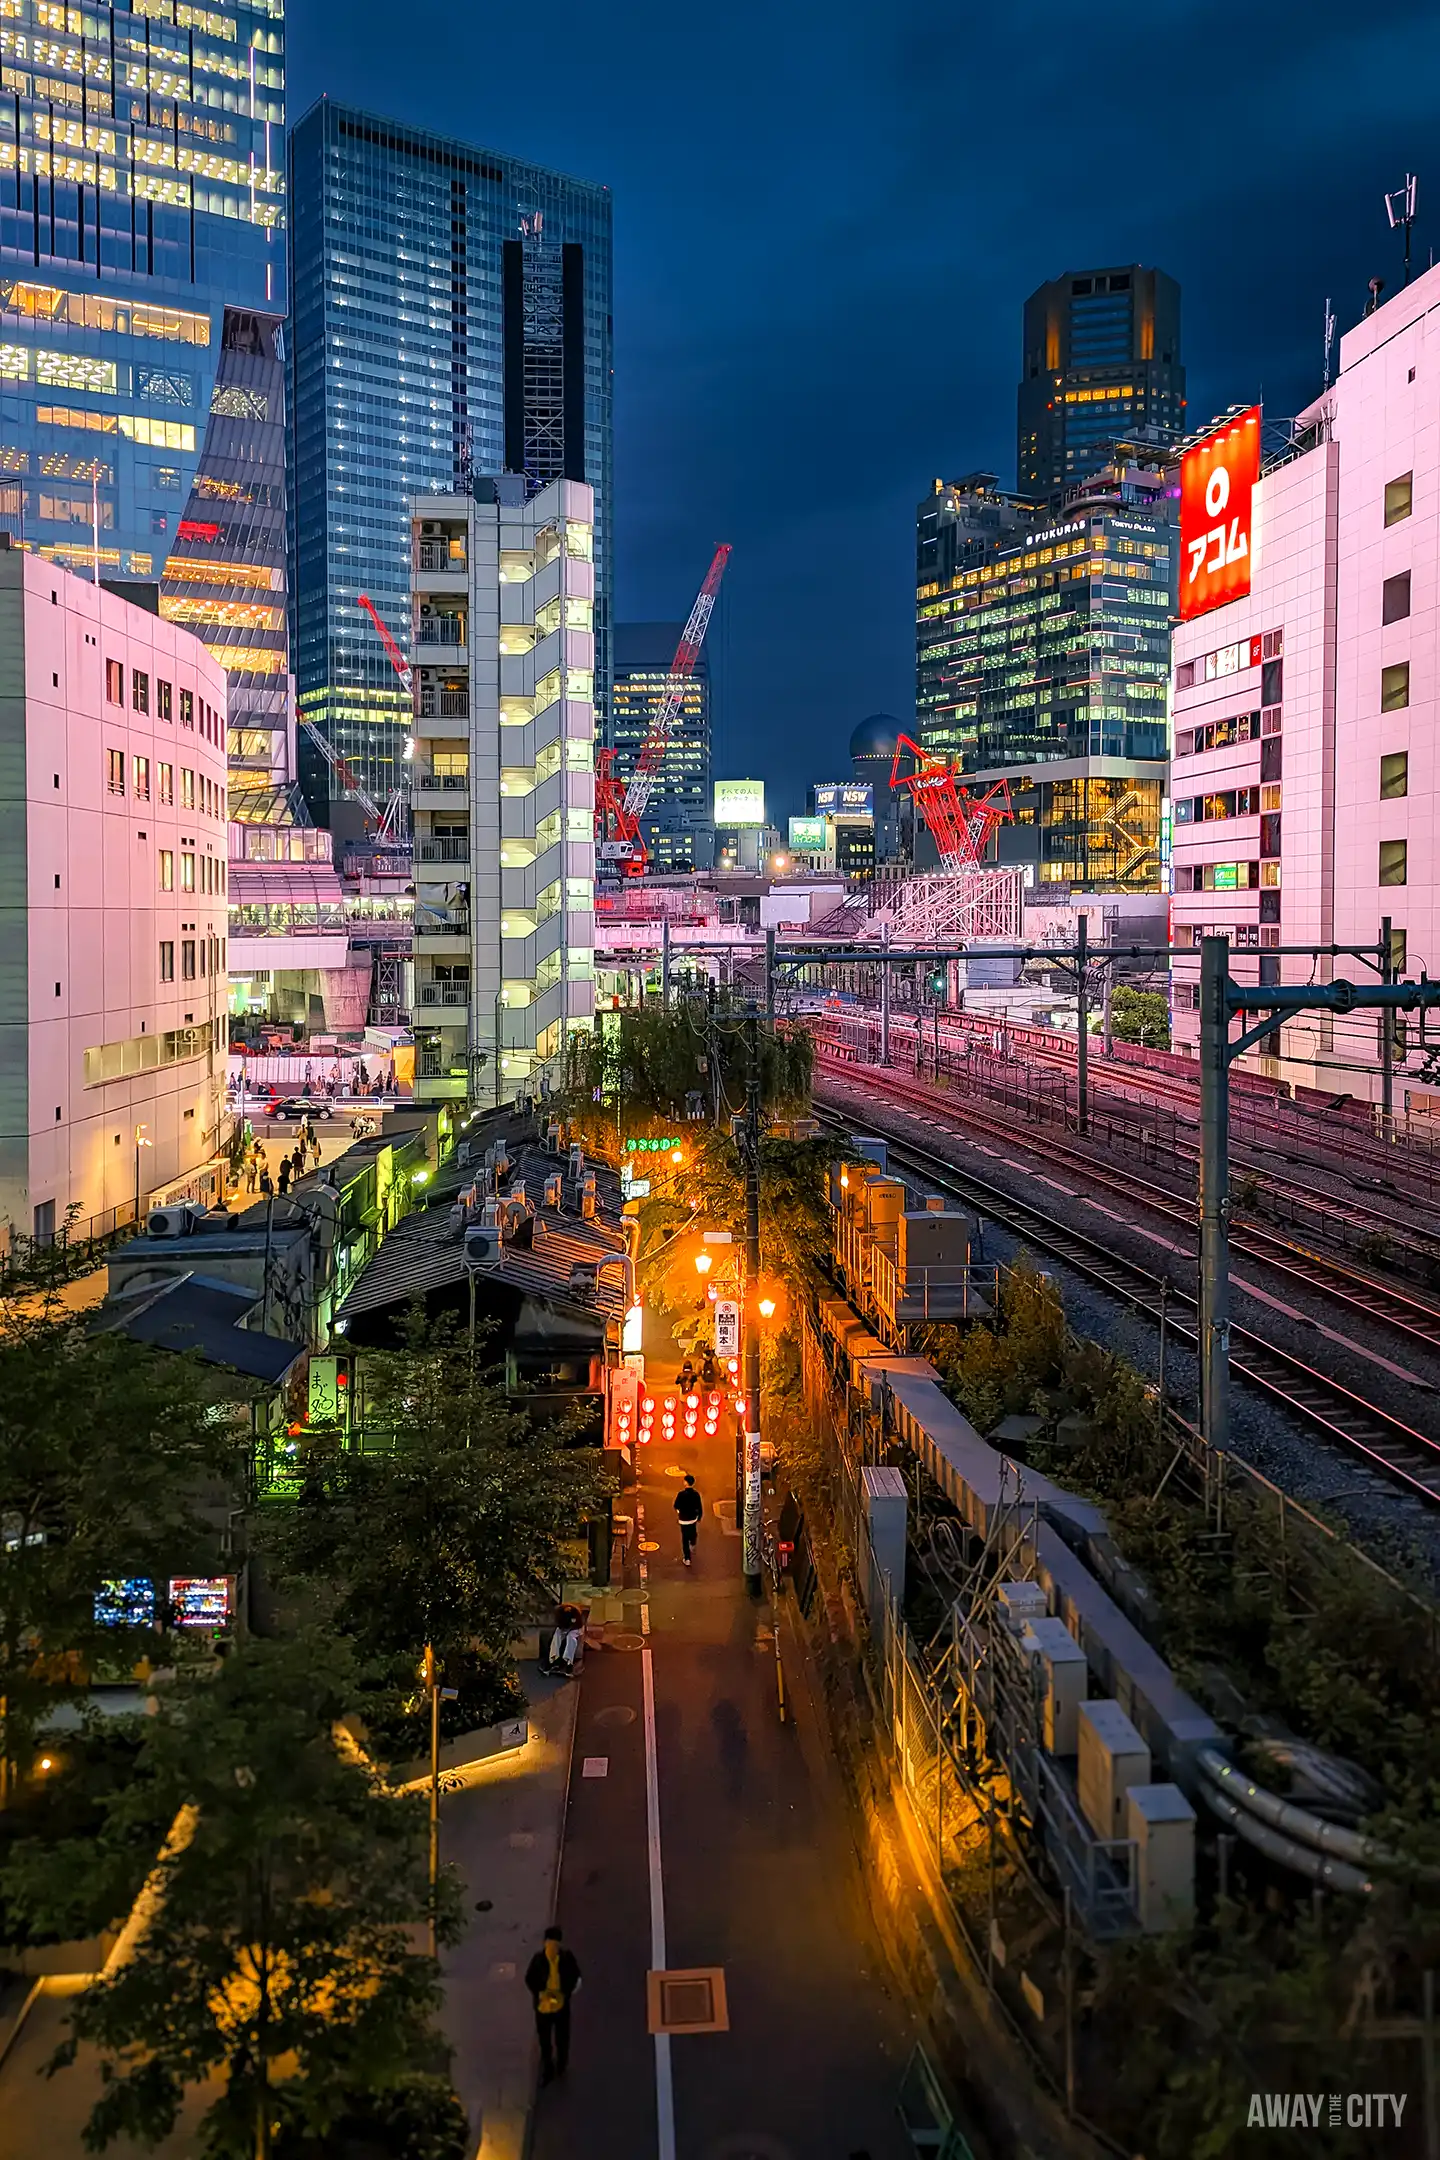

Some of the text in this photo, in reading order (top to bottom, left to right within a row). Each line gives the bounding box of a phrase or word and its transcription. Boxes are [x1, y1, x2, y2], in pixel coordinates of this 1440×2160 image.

[1034, 519, 1087, 543] FUKURAS
[1187, 516, 1249, 584] アコム
[1252, 645, 1260, 657] 8F
[818, 791, 835, 804] NSW
[842, 790, 868, 803] NSW
